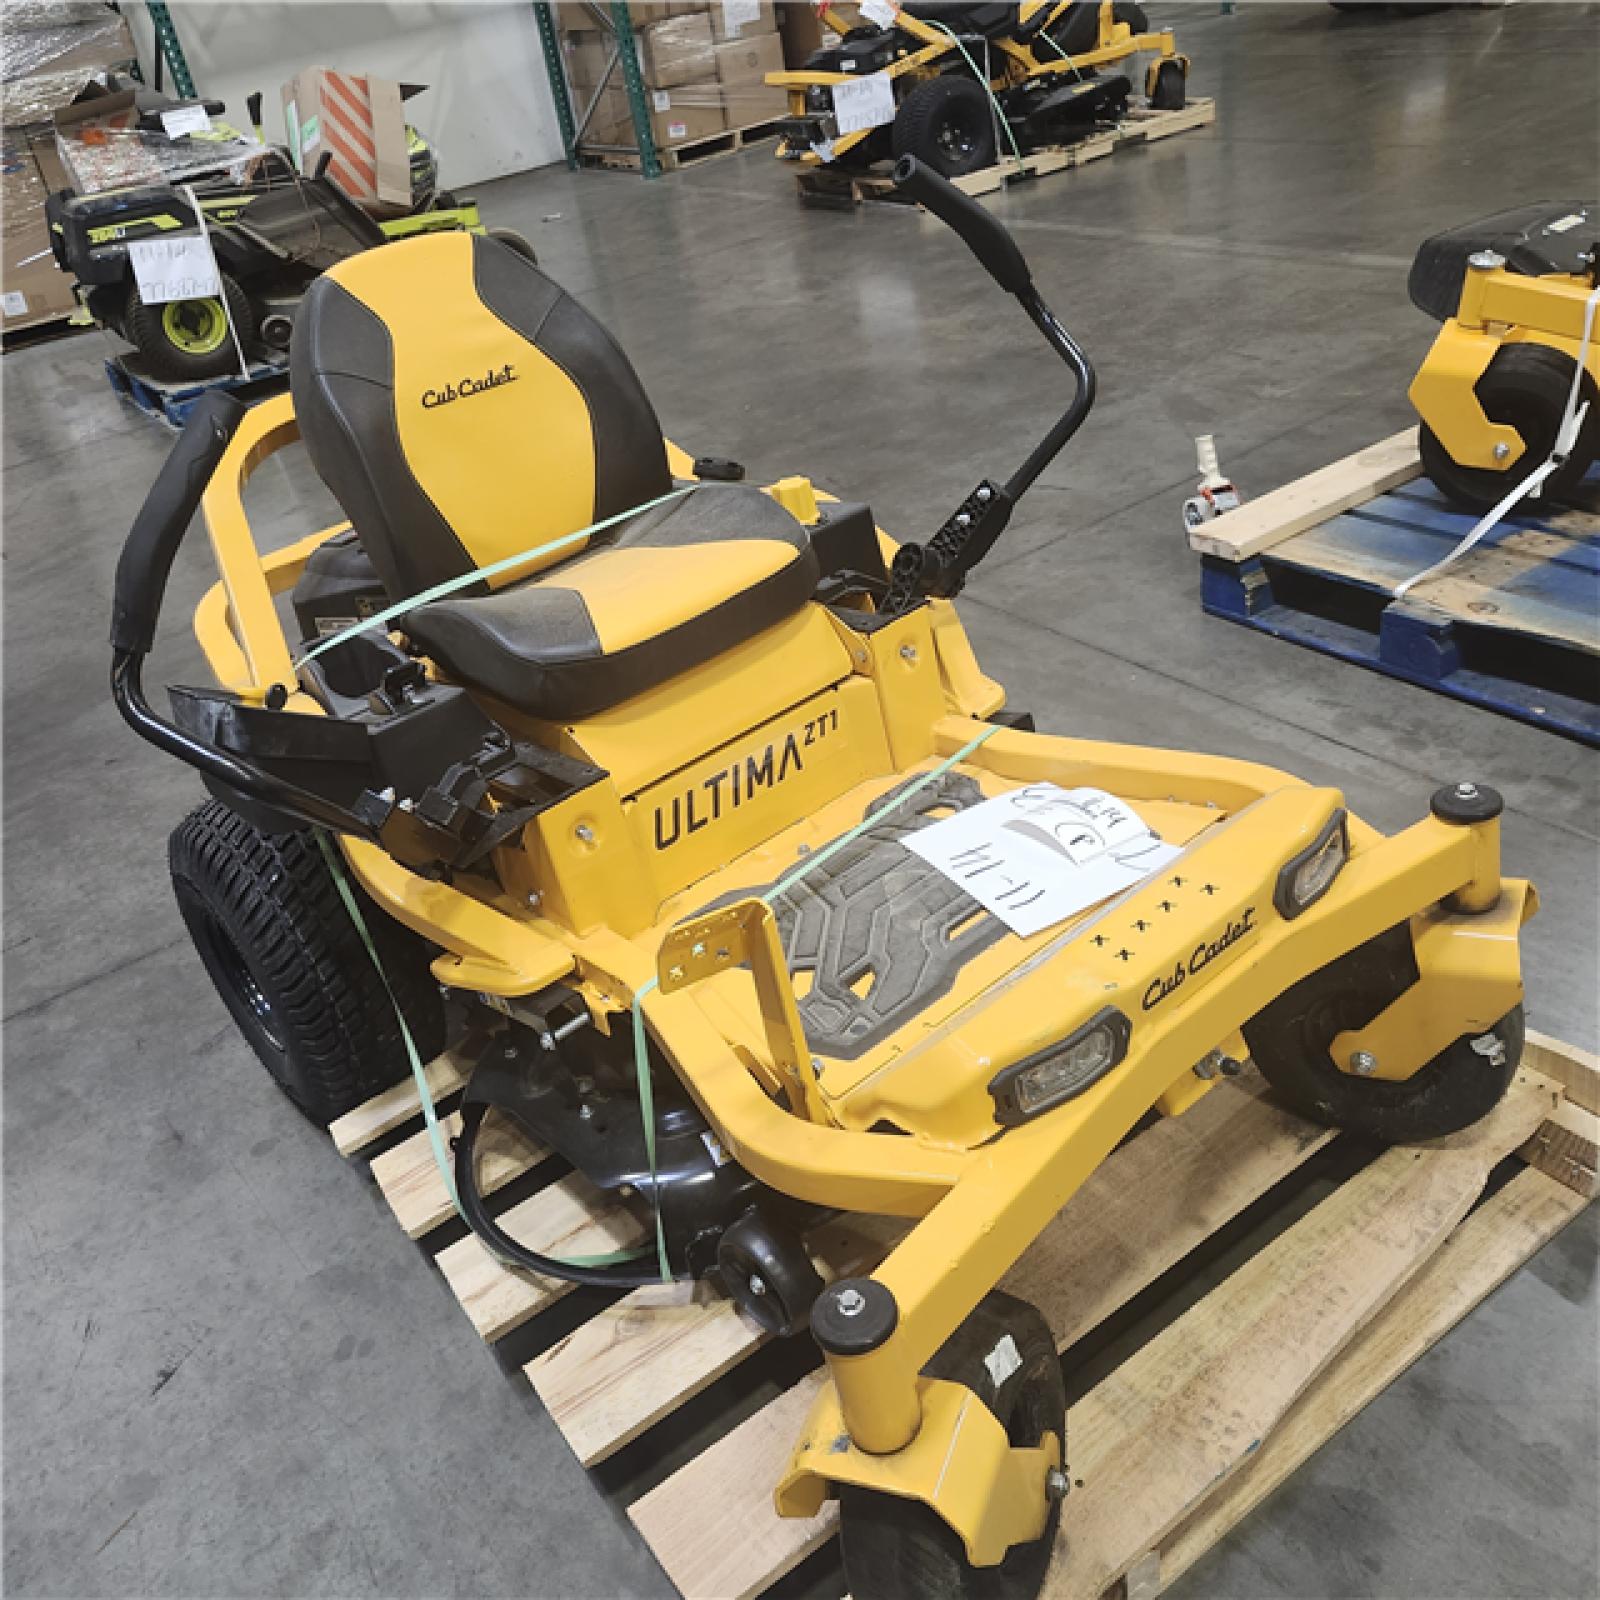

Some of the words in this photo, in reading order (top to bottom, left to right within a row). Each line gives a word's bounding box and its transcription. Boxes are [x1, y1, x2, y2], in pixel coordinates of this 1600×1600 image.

[421, 383, 457, 409] Cub
[458, 364, 520, 397] Cadet
[654, 735, 803, 850] ULTIMA
[804, 709, 839, 746] ZT1
[1142, 962, 1186, 1010] Cub
[1188, 907, 1258, 975] Cadet
